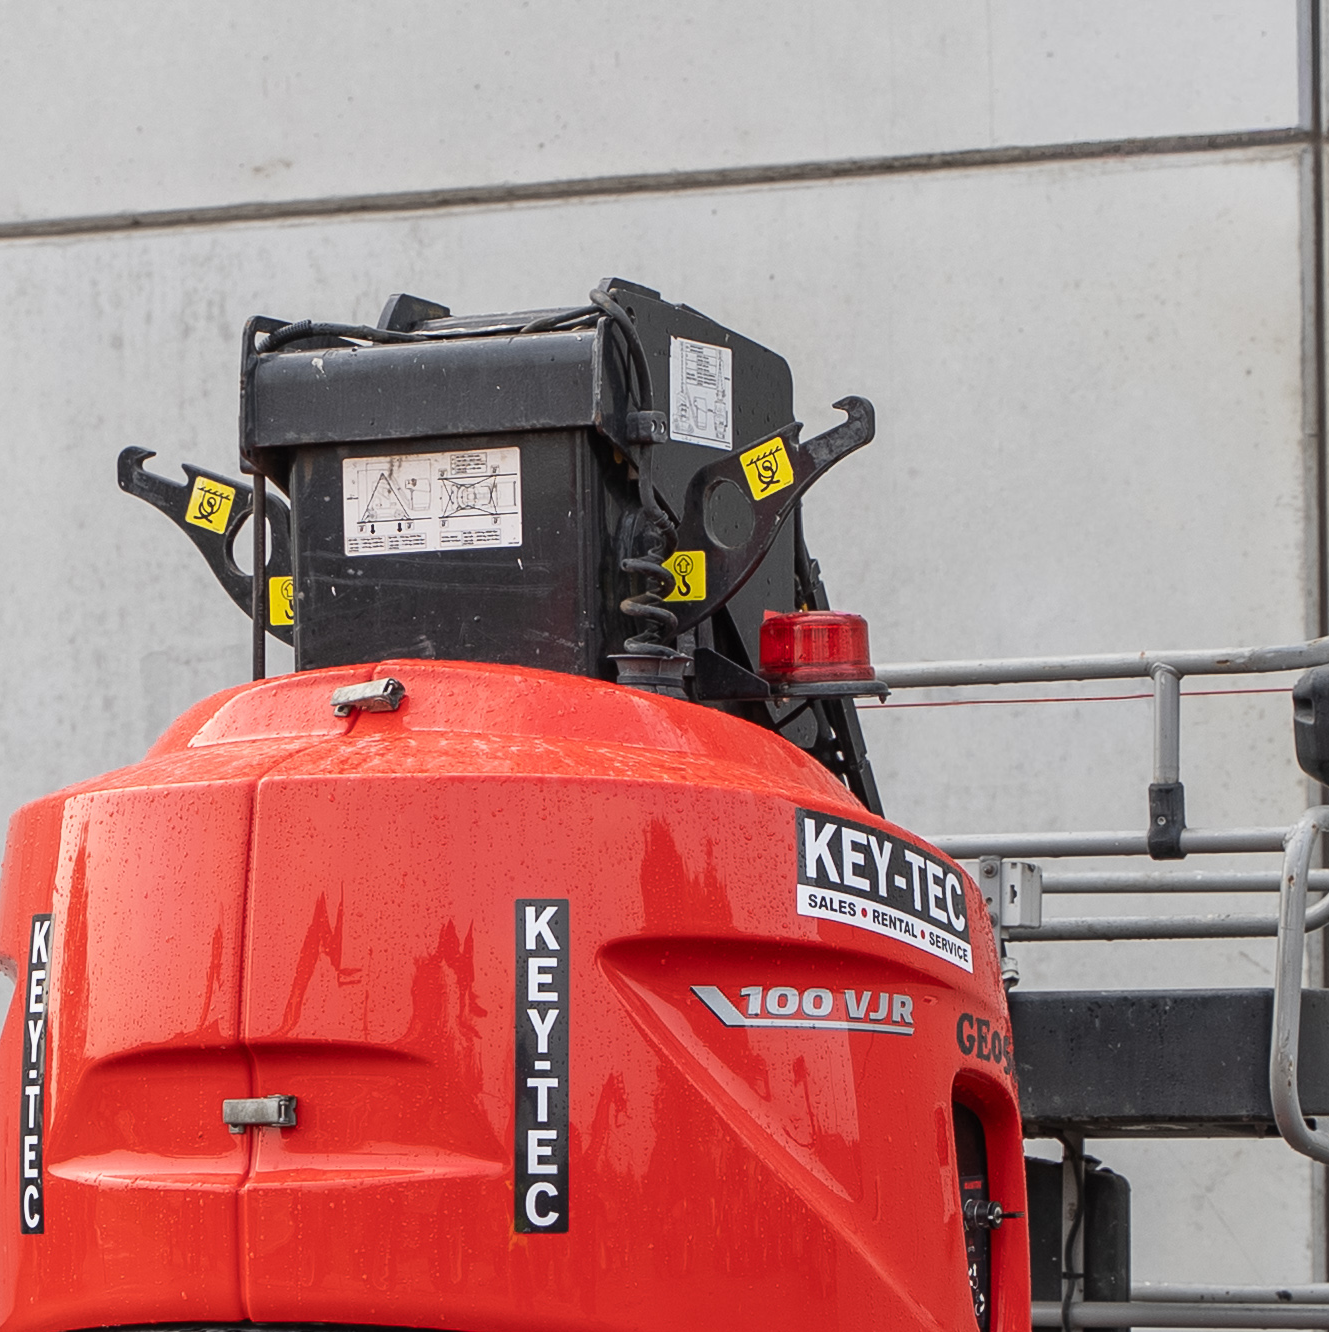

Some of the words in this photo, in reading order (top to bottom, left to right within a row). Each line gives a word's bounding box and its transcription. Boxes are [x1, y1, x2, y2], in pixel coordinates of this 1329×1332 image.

[803, 817, 966, 933] KEY-TEC
[807, 893, 857, 918] SALES
[872, 908, 918, 939] RENTAL
[928, 931, 969, 963] SERVICE
[739, 985, 834, 1017] 100
[843, 989, 915, 1025] VJR
[23, 919, 49, 1229] KEY-TEC
[524, 905, 561, 1227] KEY-TEC
